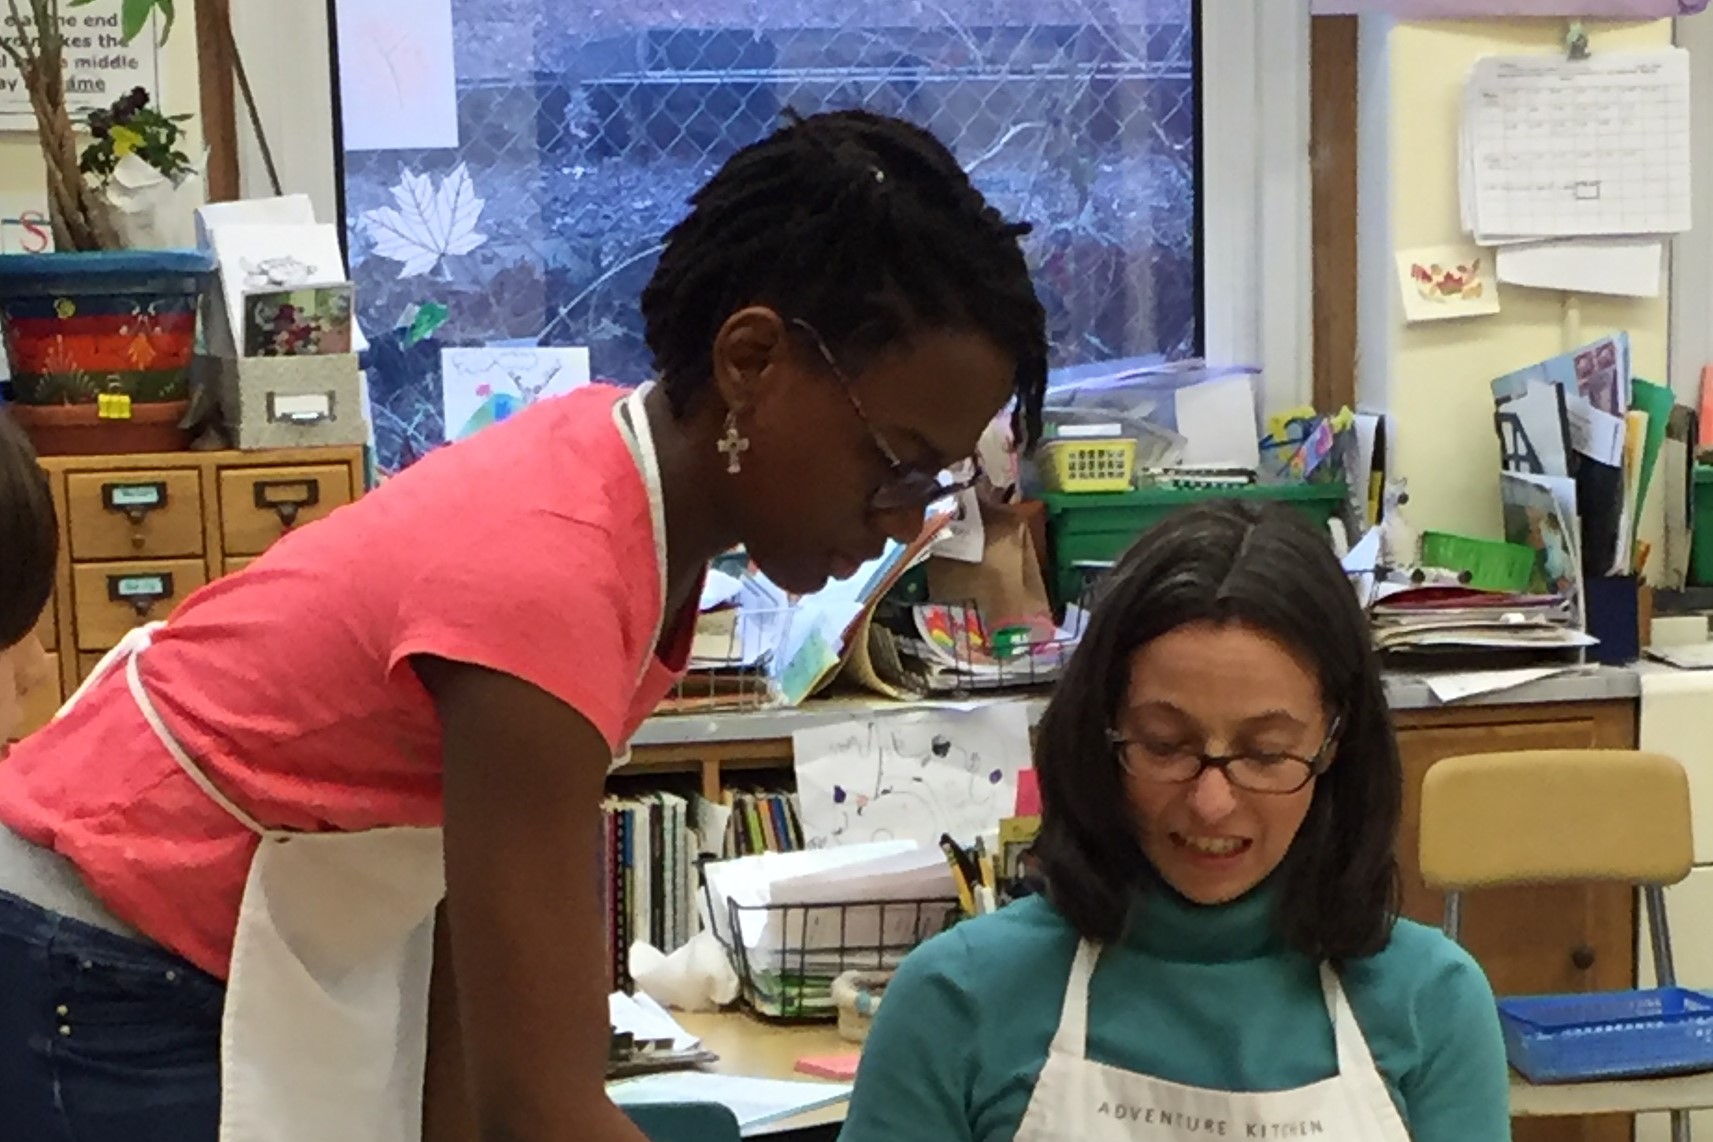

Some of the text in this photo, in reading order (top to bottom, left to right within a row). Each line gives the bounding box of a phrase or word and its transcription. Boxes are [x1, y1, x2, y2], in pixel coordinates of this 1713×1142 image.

[83, 13, 118, 27] end
[75, 54, 139, 69] middle
[1098, 1101, 1324, 1139] ADVENTURE KITCHEN
